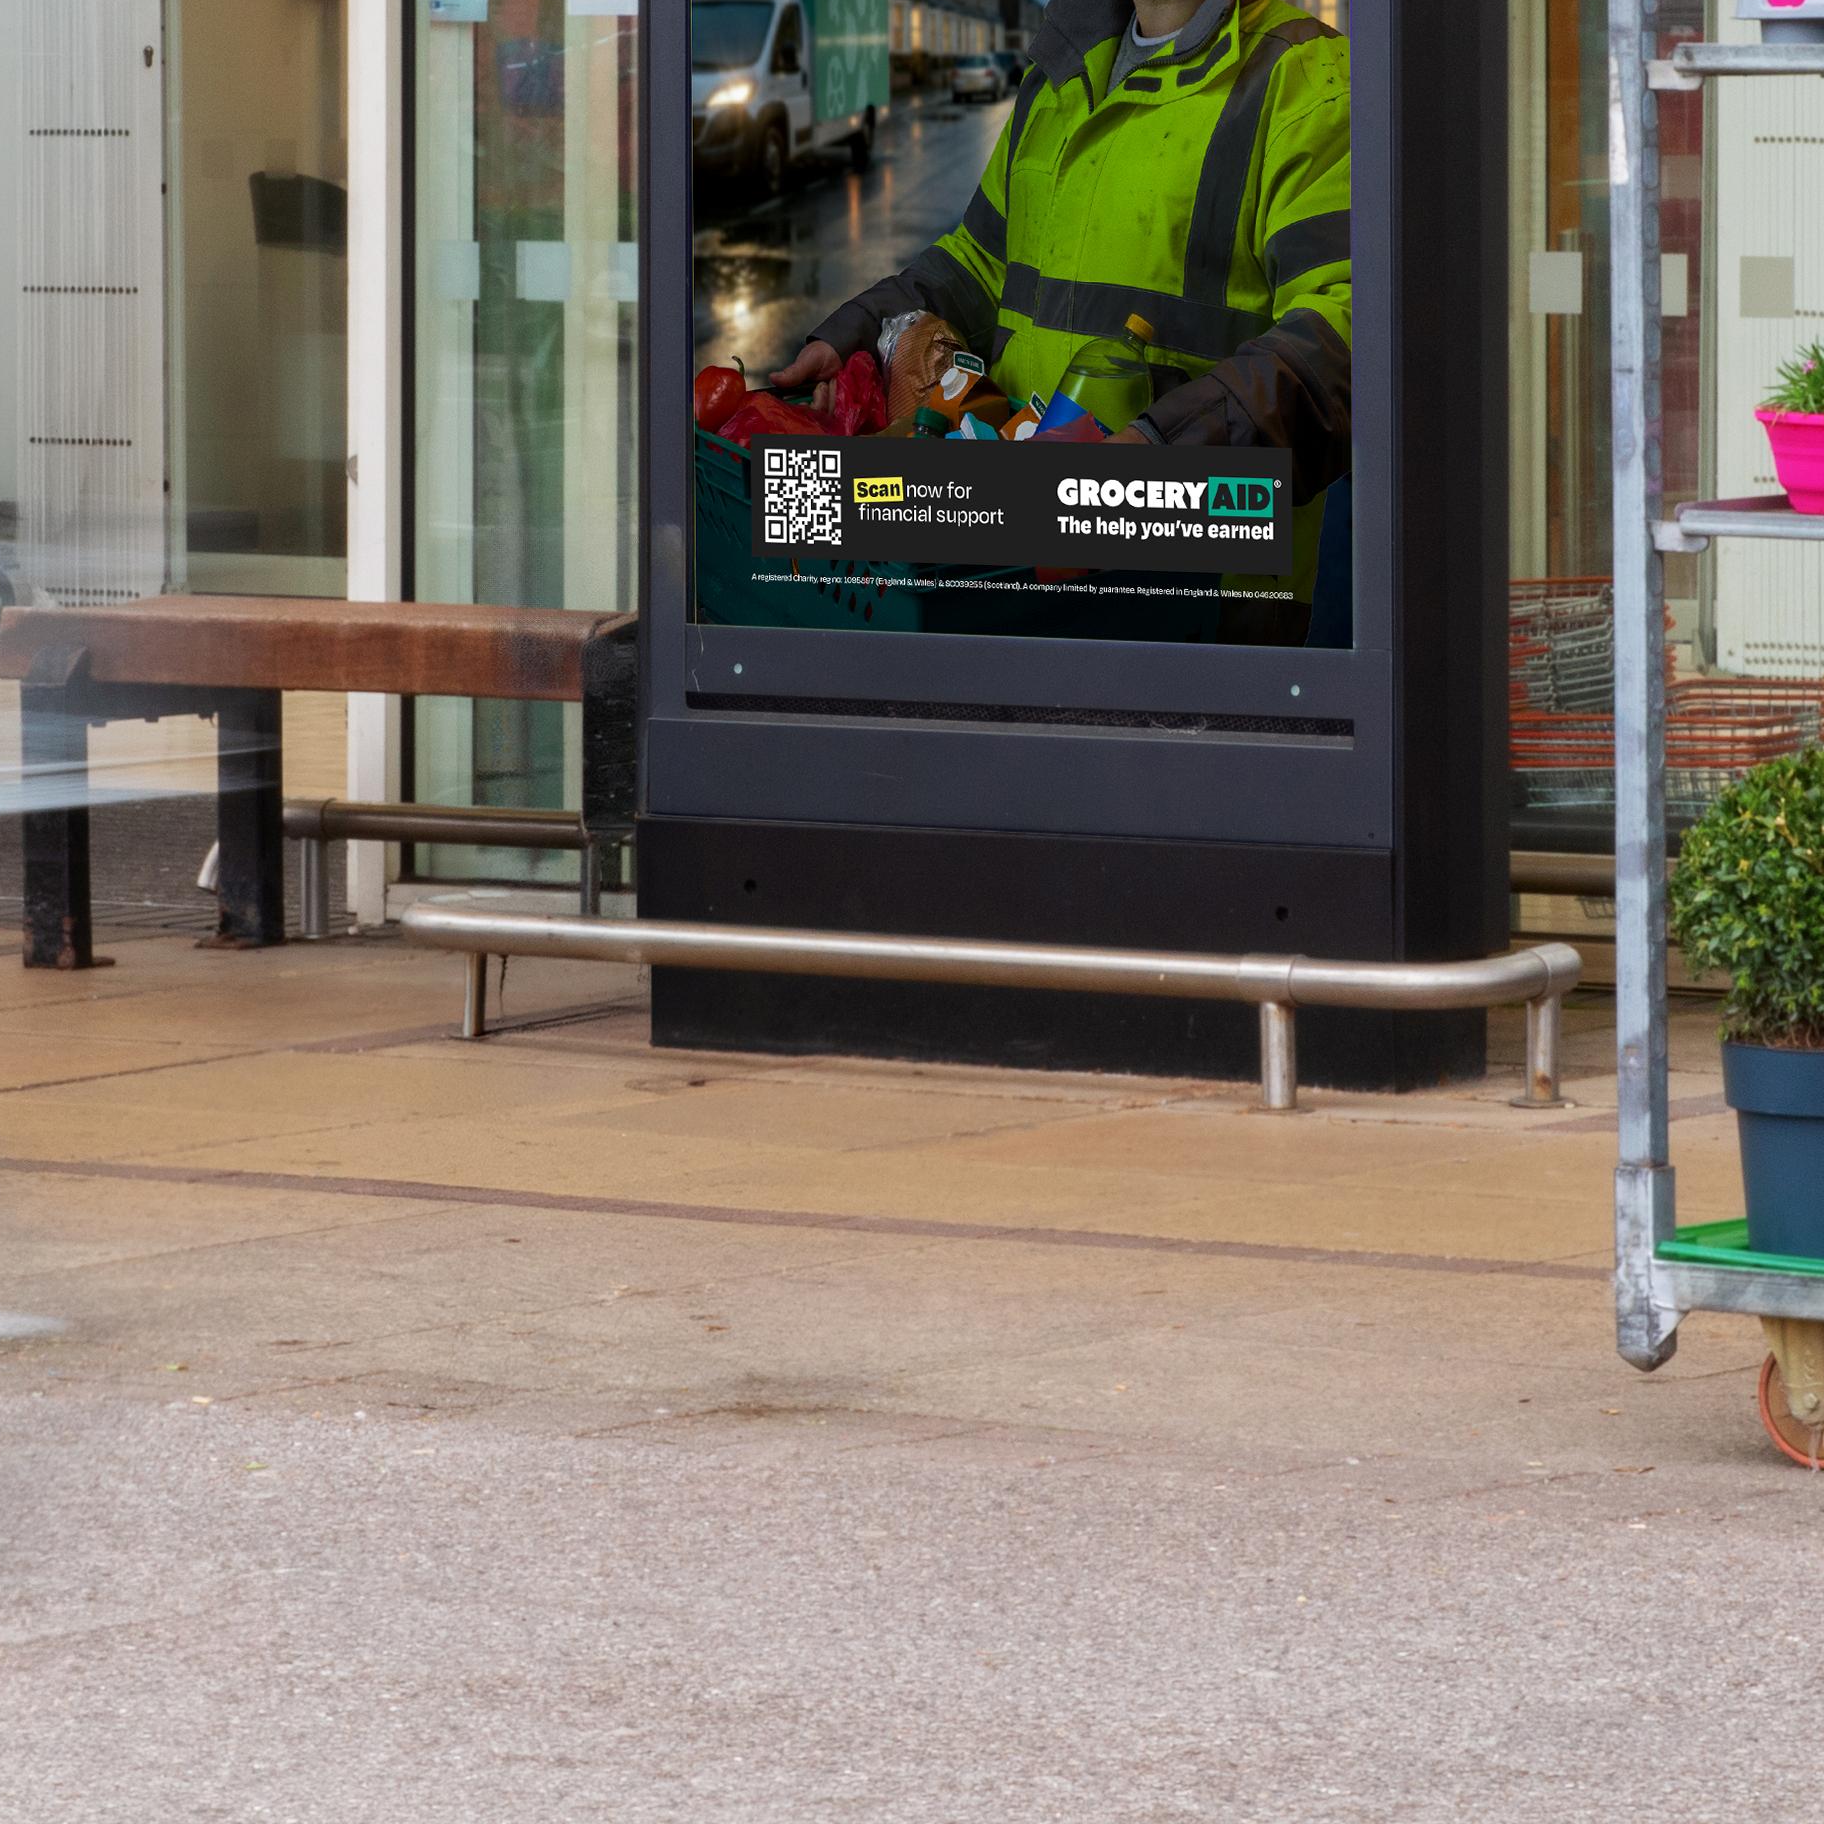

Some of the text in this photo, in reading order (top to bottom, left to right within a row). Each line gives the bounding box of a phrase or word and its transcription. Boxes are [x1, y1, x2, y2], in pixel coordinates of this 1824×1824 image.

[857, 481, 972, 499] Scan now for
[858, 504, 1004, 526] financial support
[1057, 516, 1092, 535] The
[1096, 516, 1137, 540] help
[1207, 522, 1274, 540] earned
[757, 573, 792, 583] registered
[875, 576, 906, 587] (England
[1029, 583, 1062, 592] company
[1063, 583, 1087, 592] limited
[1137, 586, 1175, 596] Registered
[1183, 588, 1213, 598] England
